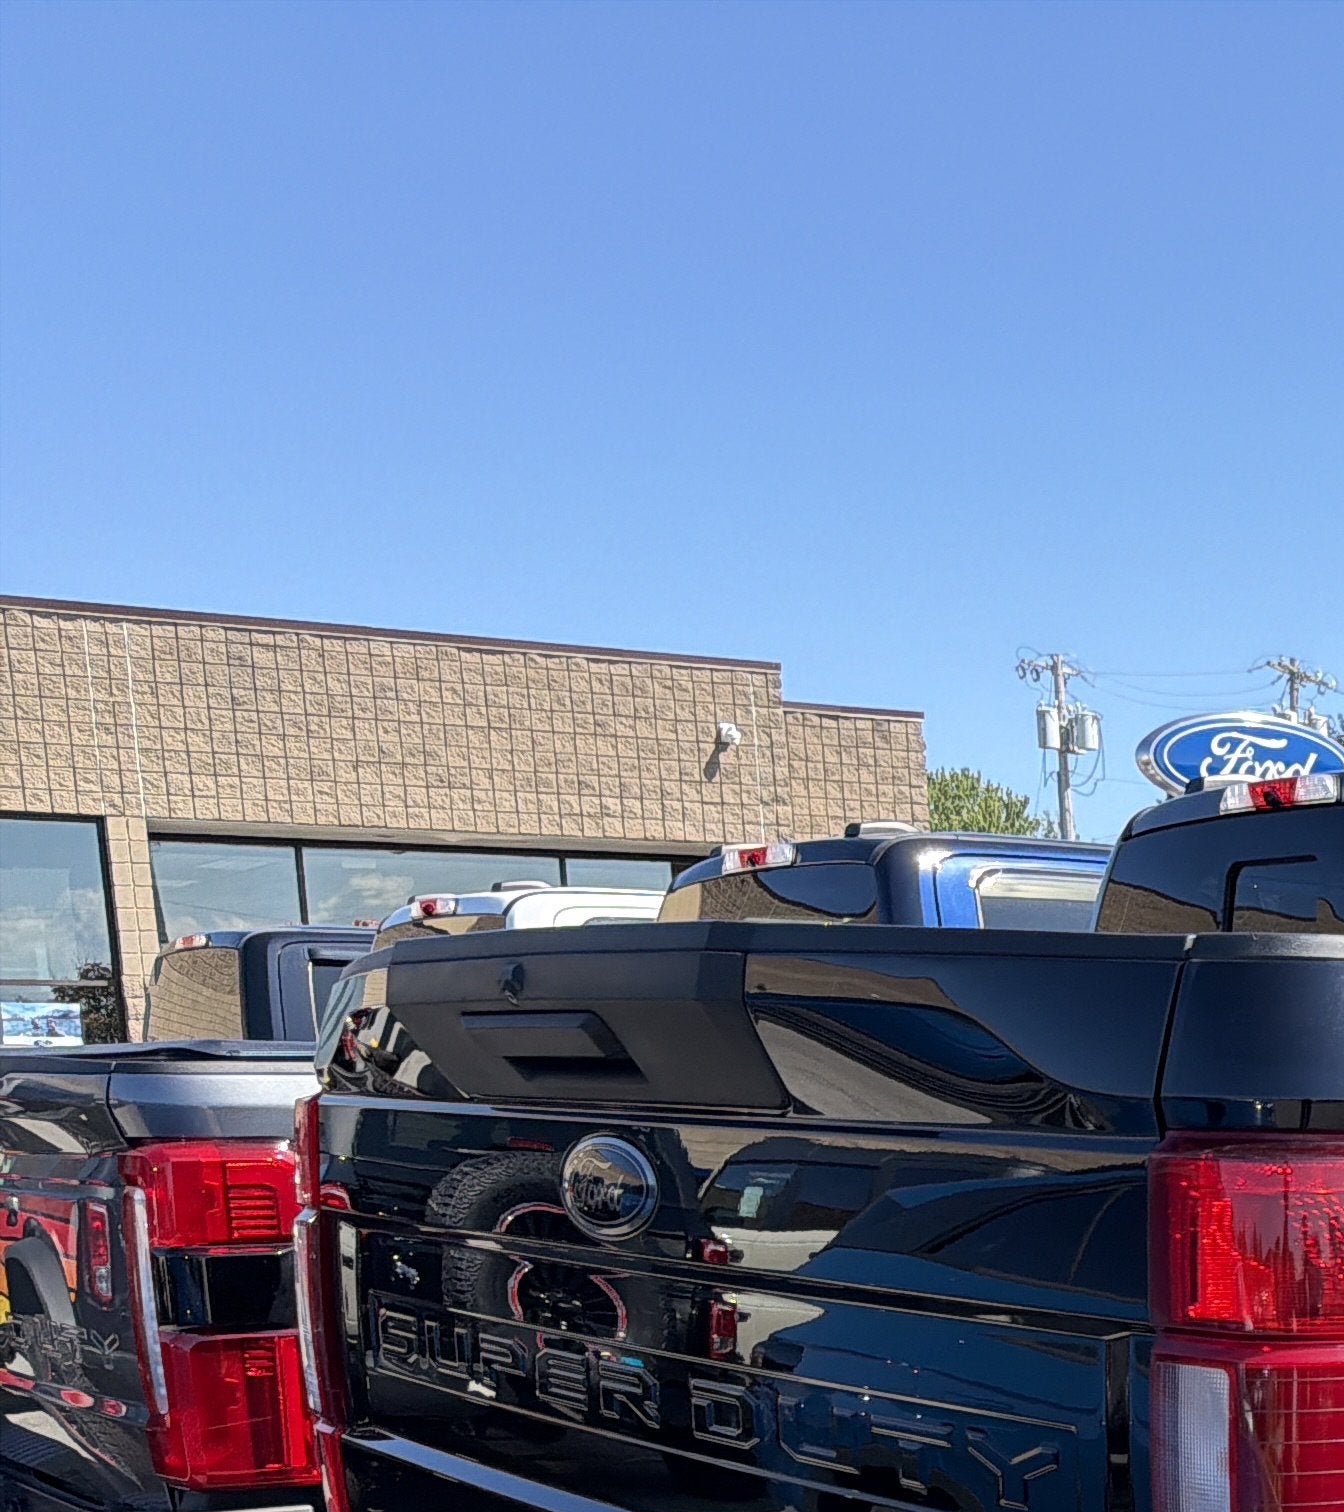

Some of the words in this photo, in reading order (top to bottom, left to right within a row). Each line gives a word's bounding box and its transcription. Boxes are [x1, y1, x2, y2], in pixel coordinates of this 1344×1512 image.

[1201, 731, 1318, 779] Ford
[573, 1157, 625, 1212] Ford
[377, 1307, 661, 1429] SUPER
[690, 1377, 1061, 1511] DUTY
